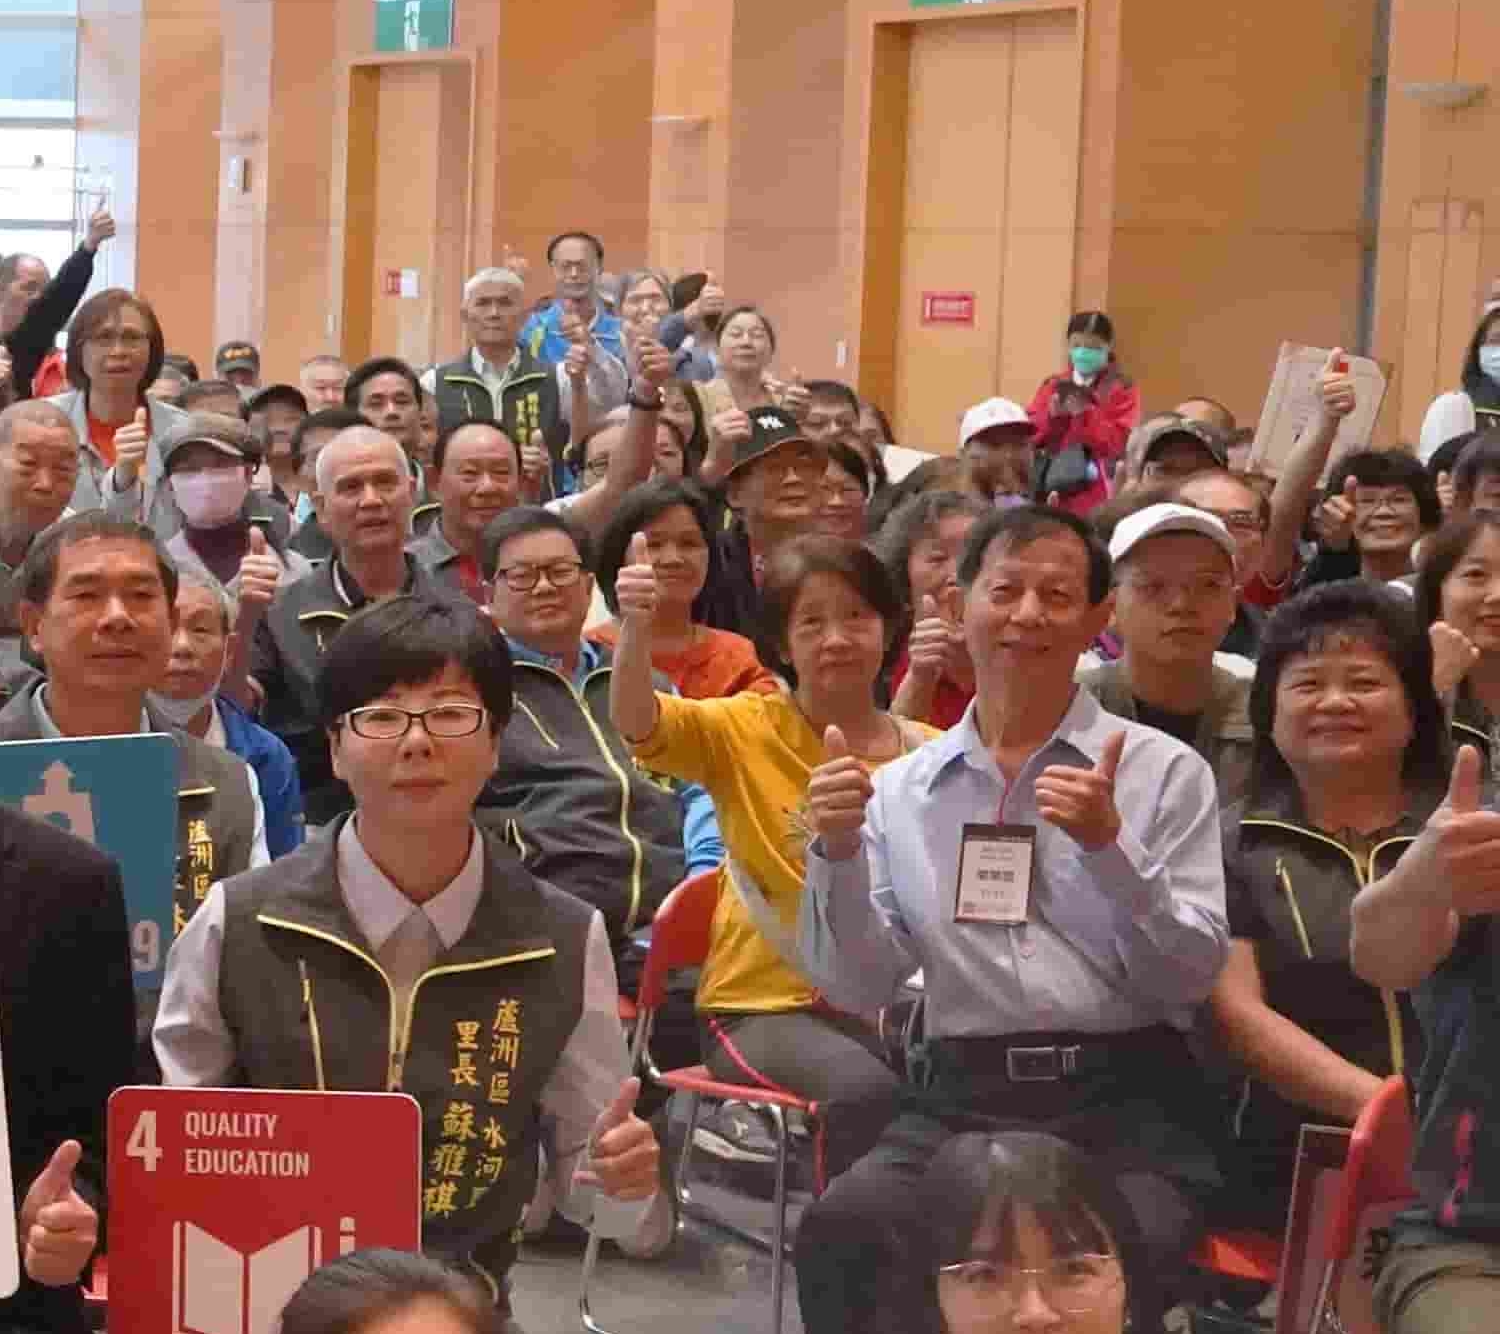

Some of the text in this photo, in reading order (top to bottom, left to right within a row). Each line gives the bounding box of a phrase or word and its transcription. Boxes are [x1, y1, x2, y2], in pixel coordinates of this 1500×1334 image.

[449, 1021, 481, 1086] 里長
[489, 999, 522, 1105] 蘆洲區
[125, 1110, 280, 1171] 4 QUALITY
[184, 1149, 310, 1176] EDUCATION
